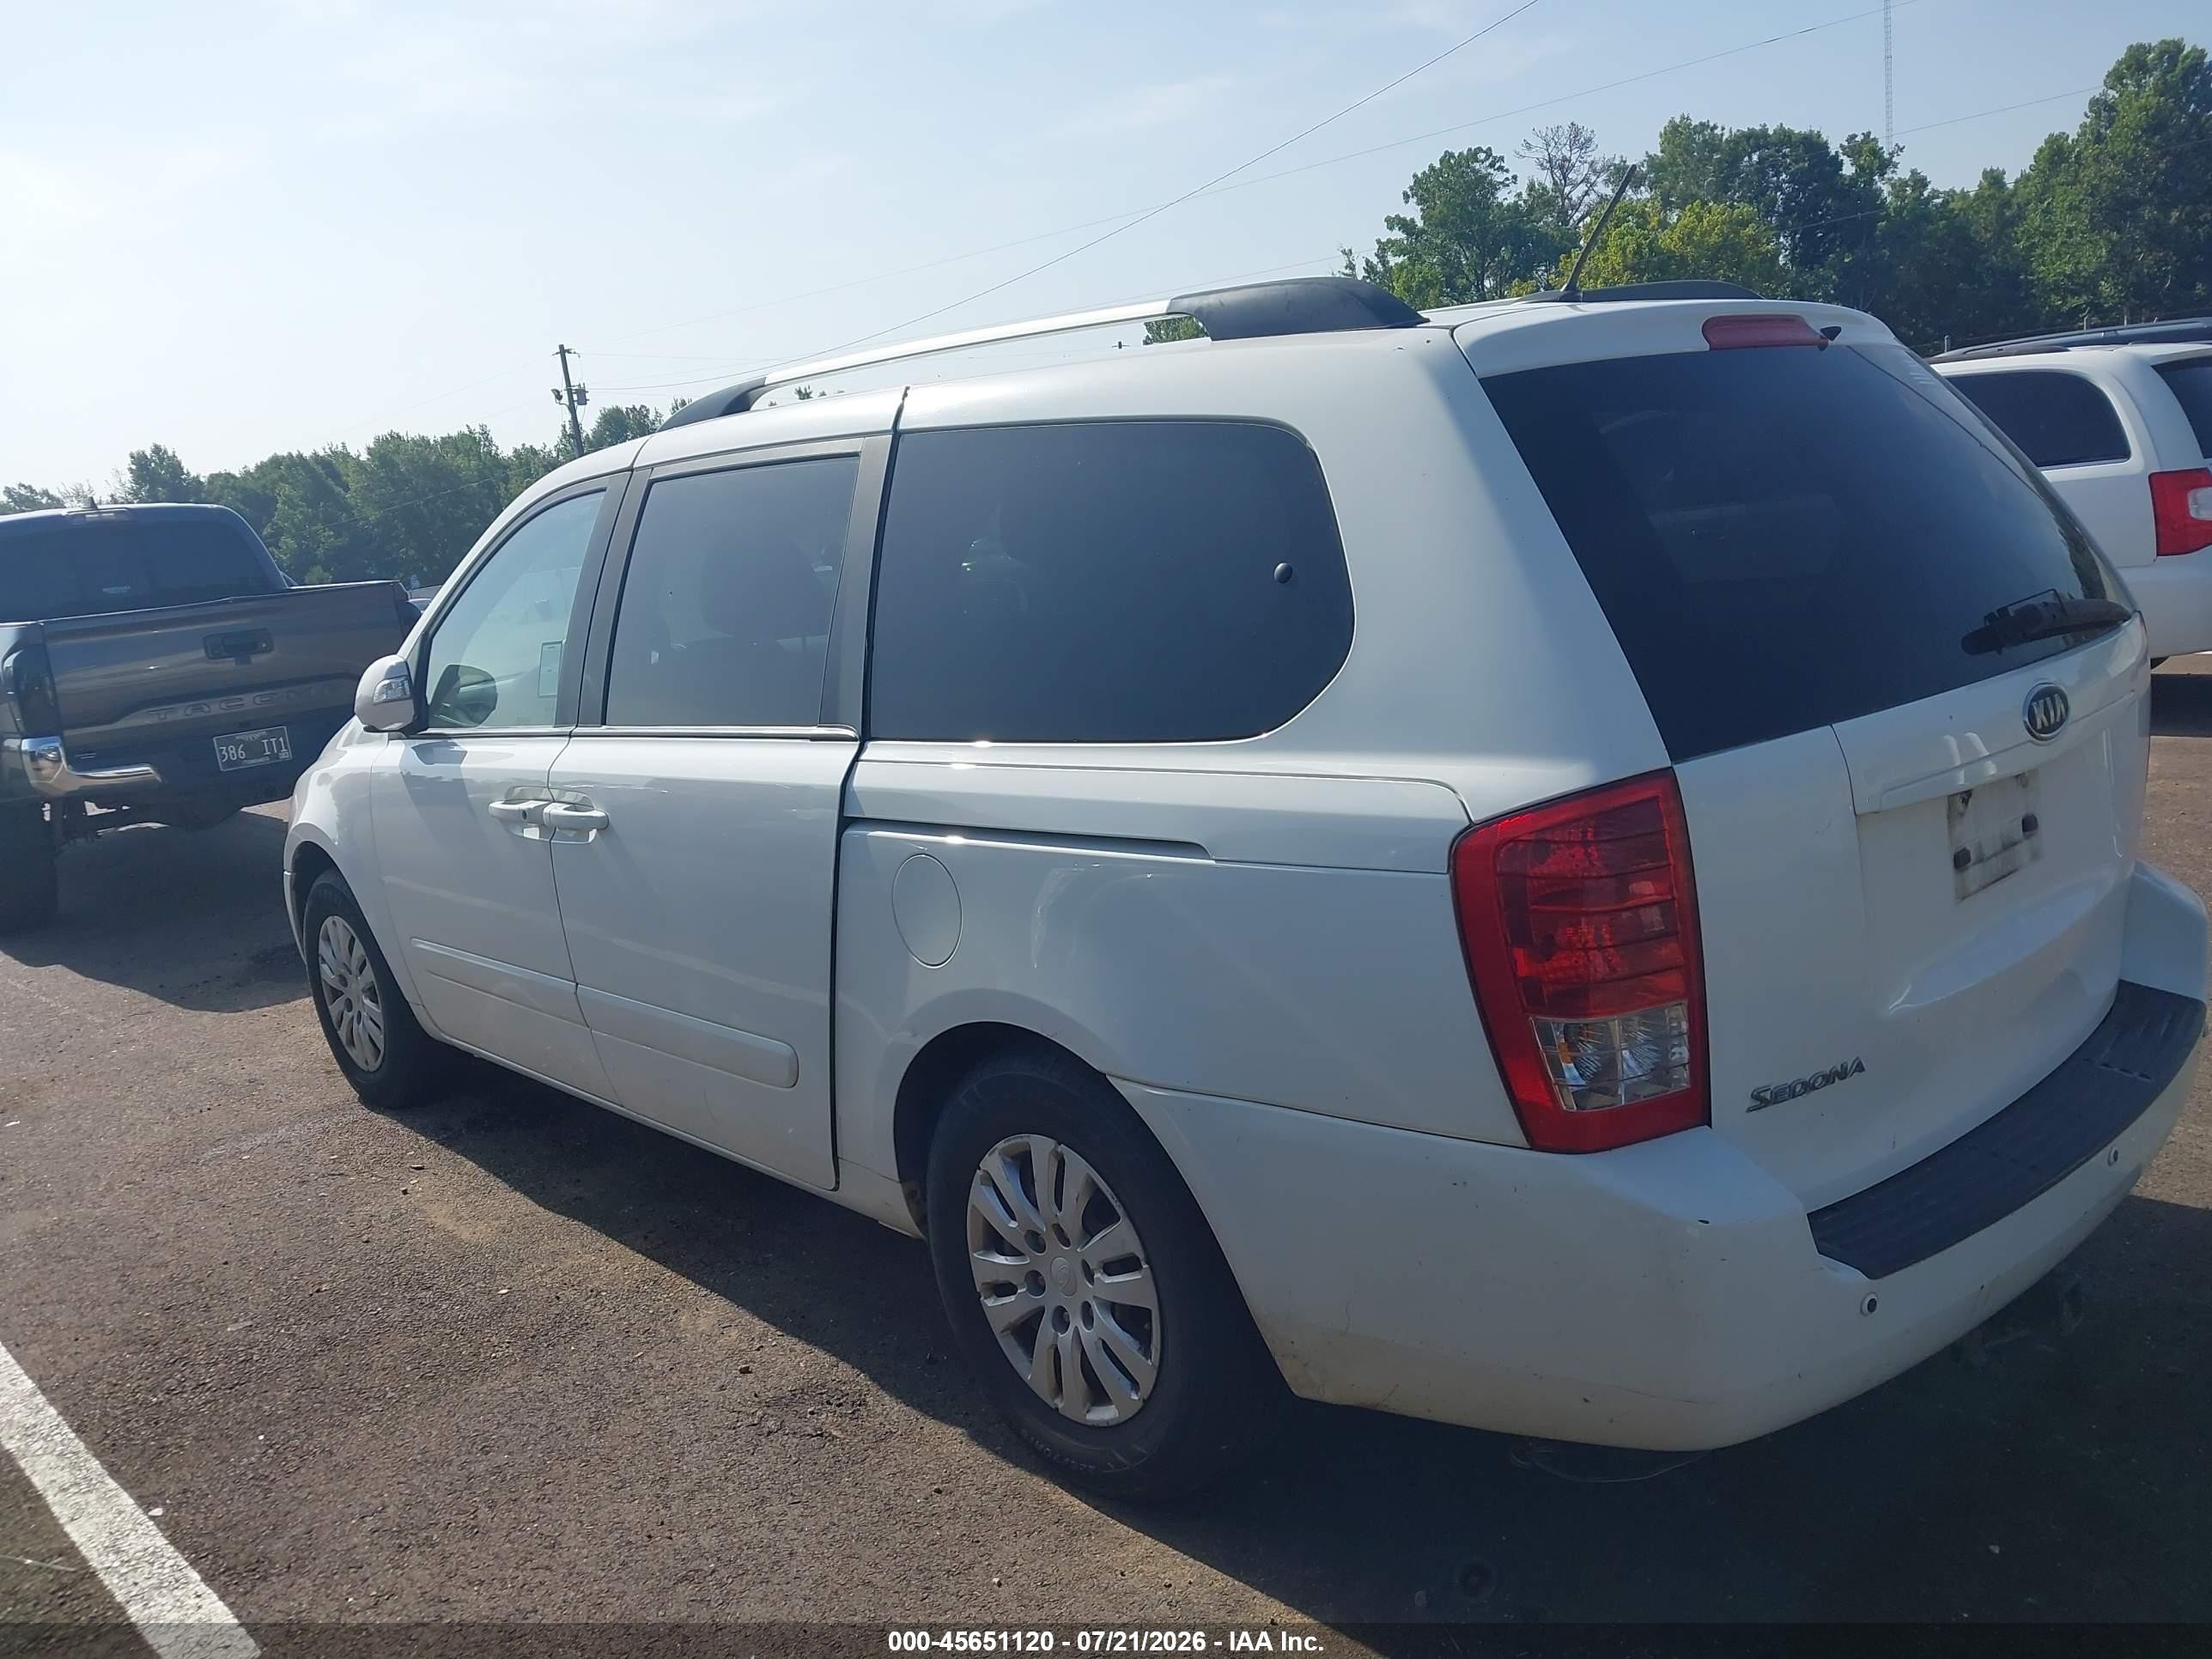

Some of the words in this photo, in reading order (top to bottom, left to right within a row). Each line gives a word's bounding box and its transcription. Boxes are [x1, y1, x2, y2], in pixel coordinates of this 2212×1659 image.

[2032, 693, 2066, 730] KIA
[219, 744, 246, 763] 386
[1745, 1055, 1866, 1114] SEDONA
